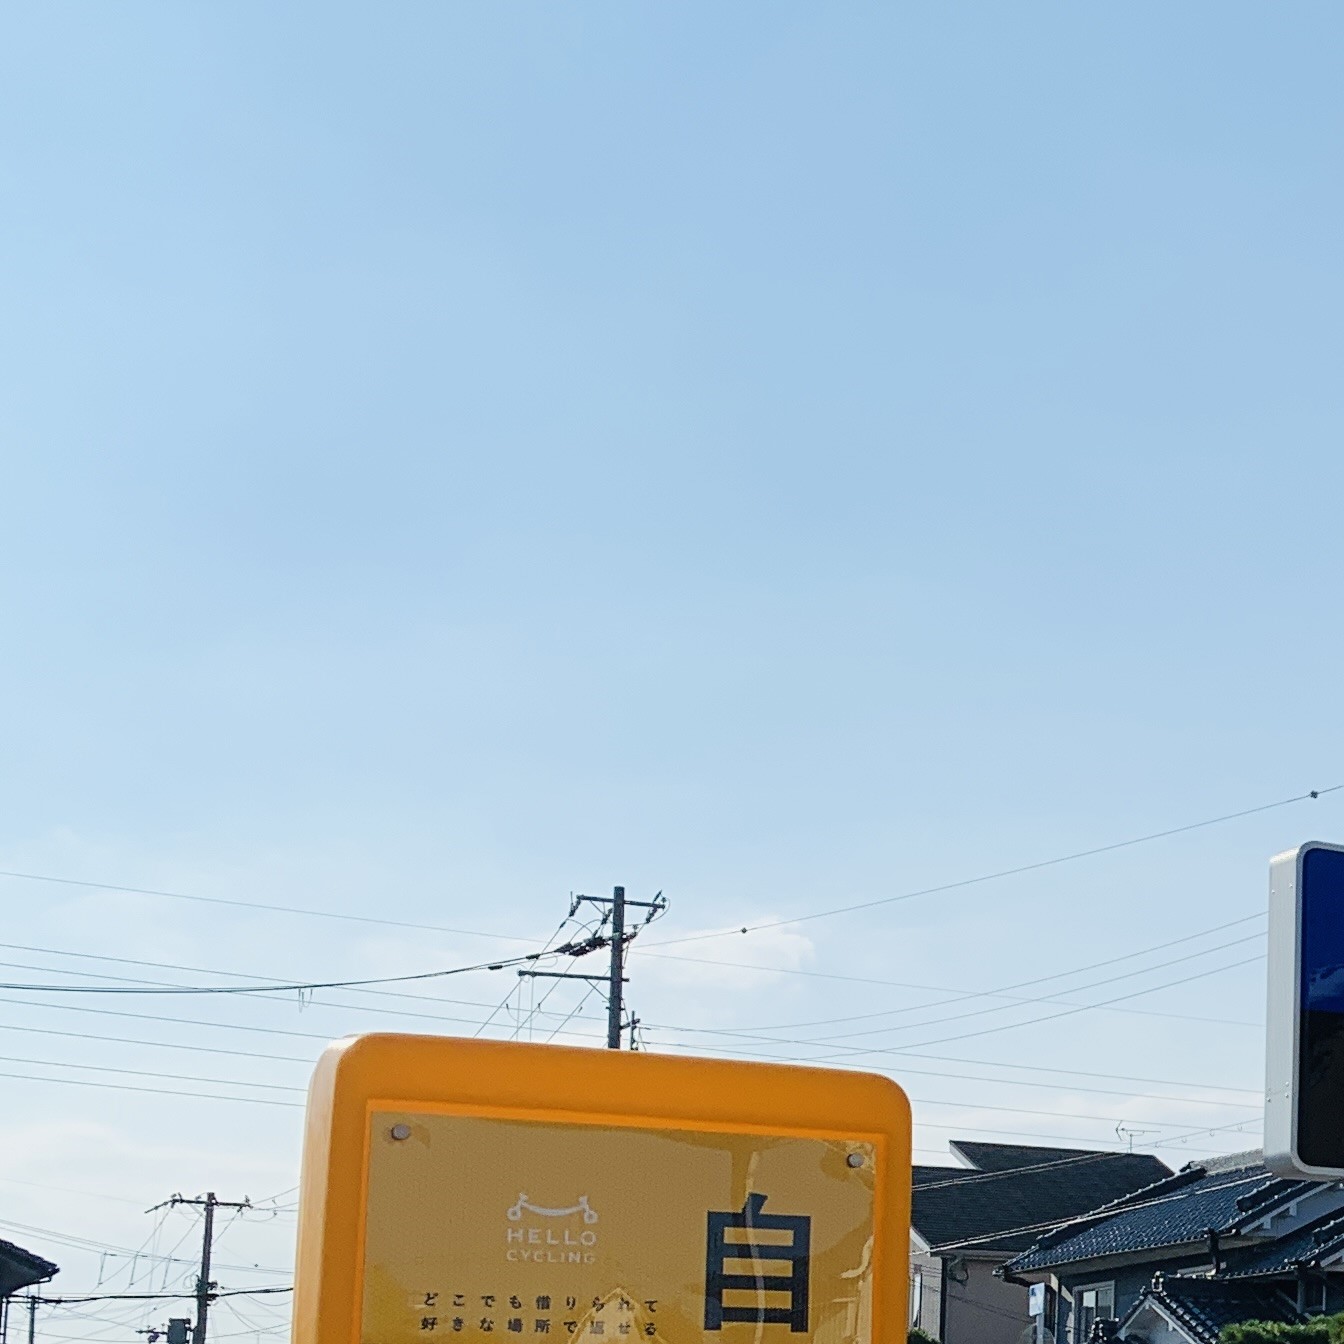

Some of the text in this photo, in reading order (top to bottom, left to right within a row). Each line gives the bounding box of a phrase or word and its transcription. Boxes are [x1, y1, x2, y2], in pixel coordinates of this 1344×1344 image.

[506, 1228, 597, 1247] HELLO
[505, 1249, 597, 1265] CYCLING
[423, 1291, 659, 1314] どこでも借りられて
[420, 1316, 658, 1337] 好きな場所で返せる
